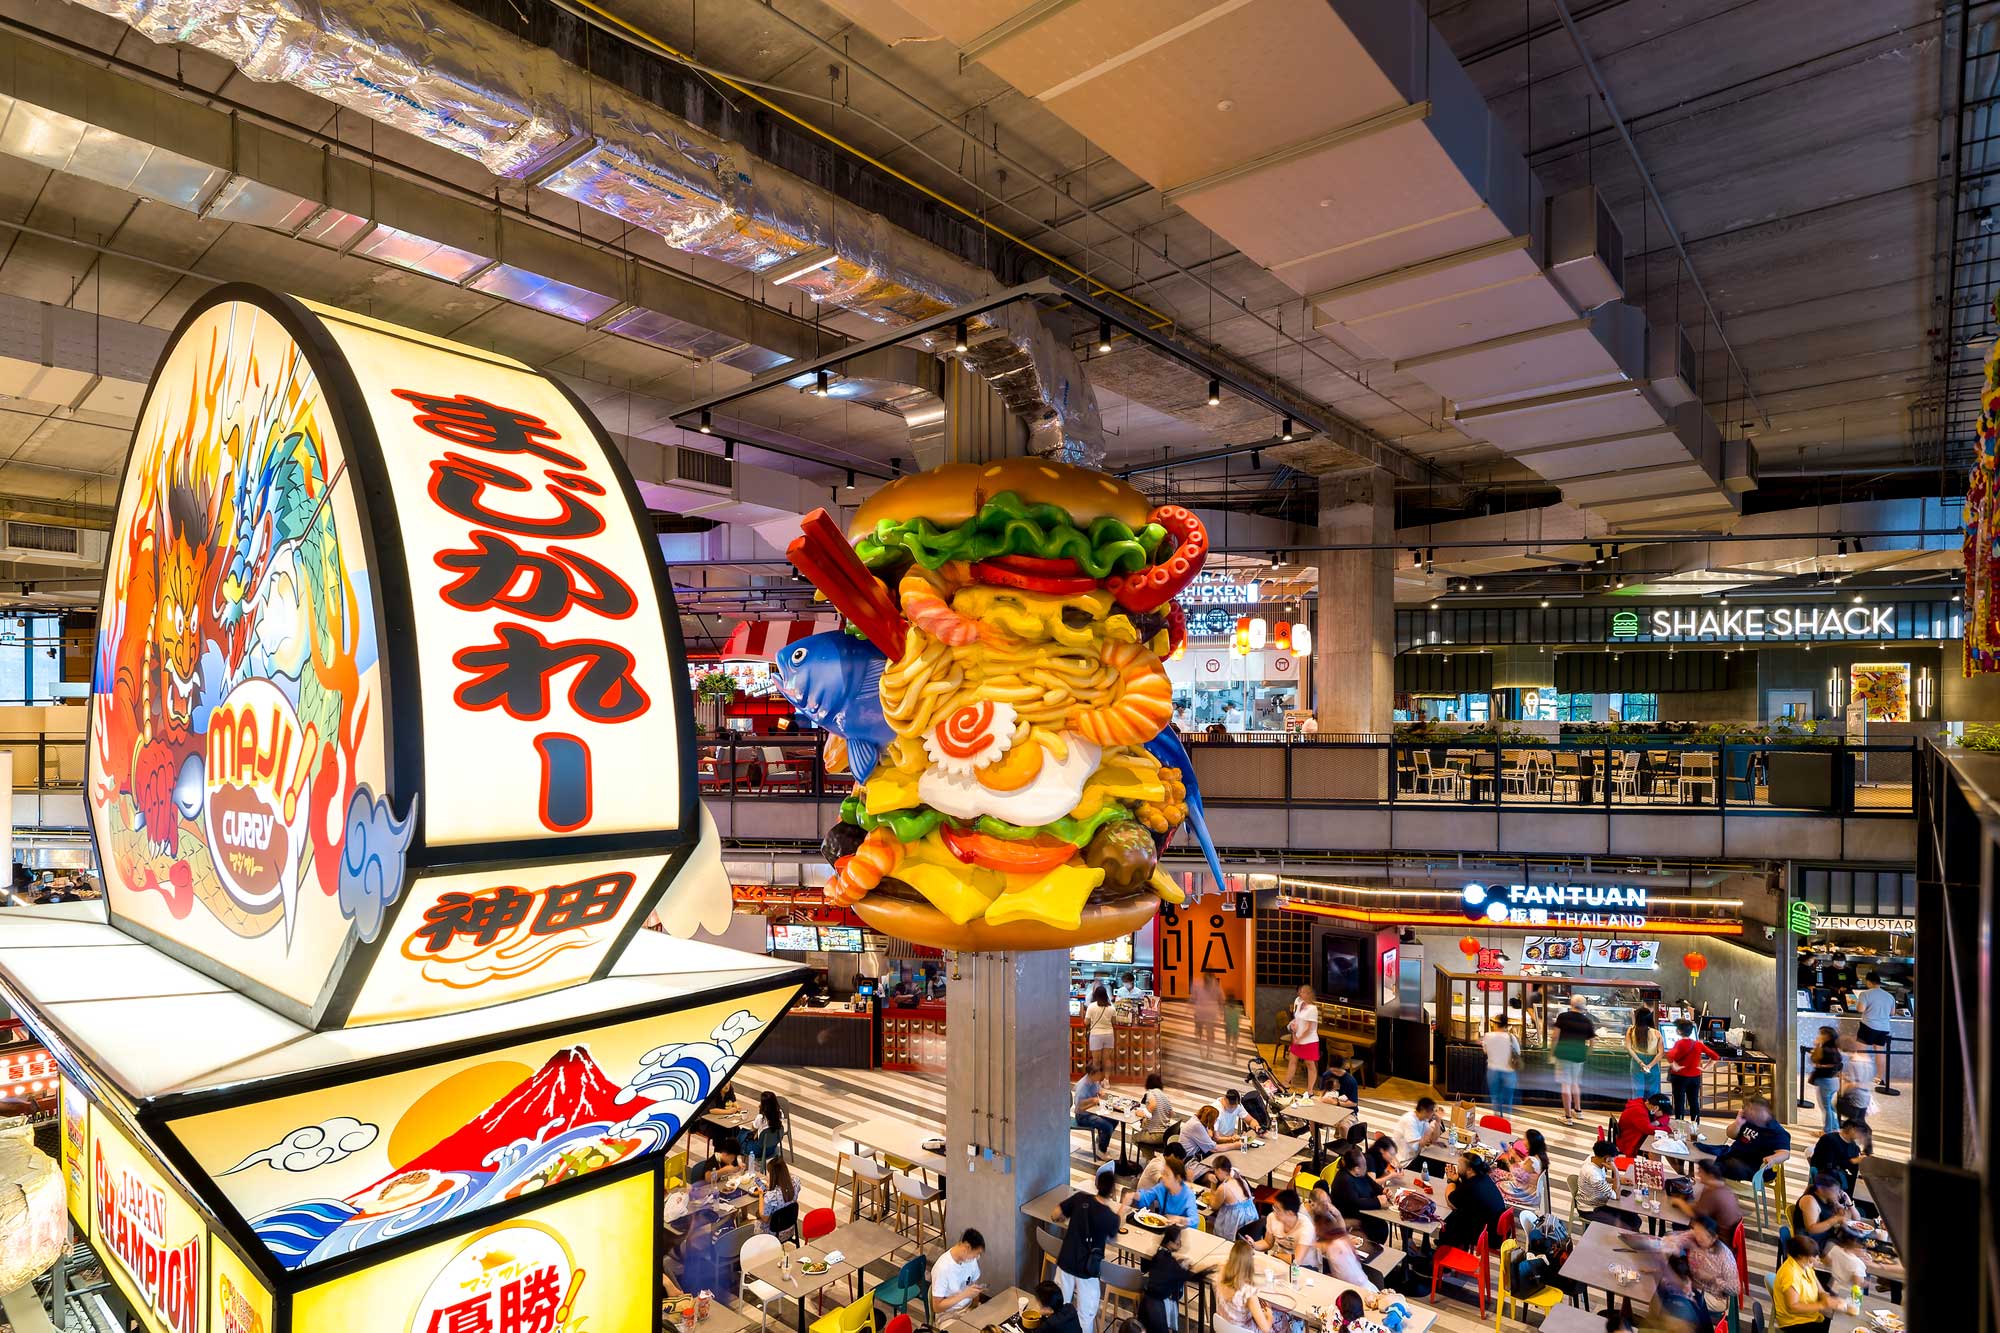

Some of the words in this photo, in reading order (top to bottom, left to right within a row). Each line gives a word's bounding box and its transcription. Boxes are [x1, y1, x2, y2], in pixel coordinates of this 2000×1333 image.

[1202, 595, 1247, 604] RAMEN
[1652, 609, 1765, 637] SHAKE
[1772, 607, 1895, 635] SHACK
[222, 809, 275, 852] CURRY
[415, 871, 637, 953] 神田
[1510, 884, 1646, 907] FANTUAN
[1553, 911, 1646, 928] THAILAND
[120, 1170, 164, 1240] JAPAN
[95, 1136, 197, 1333] CHAMPION
